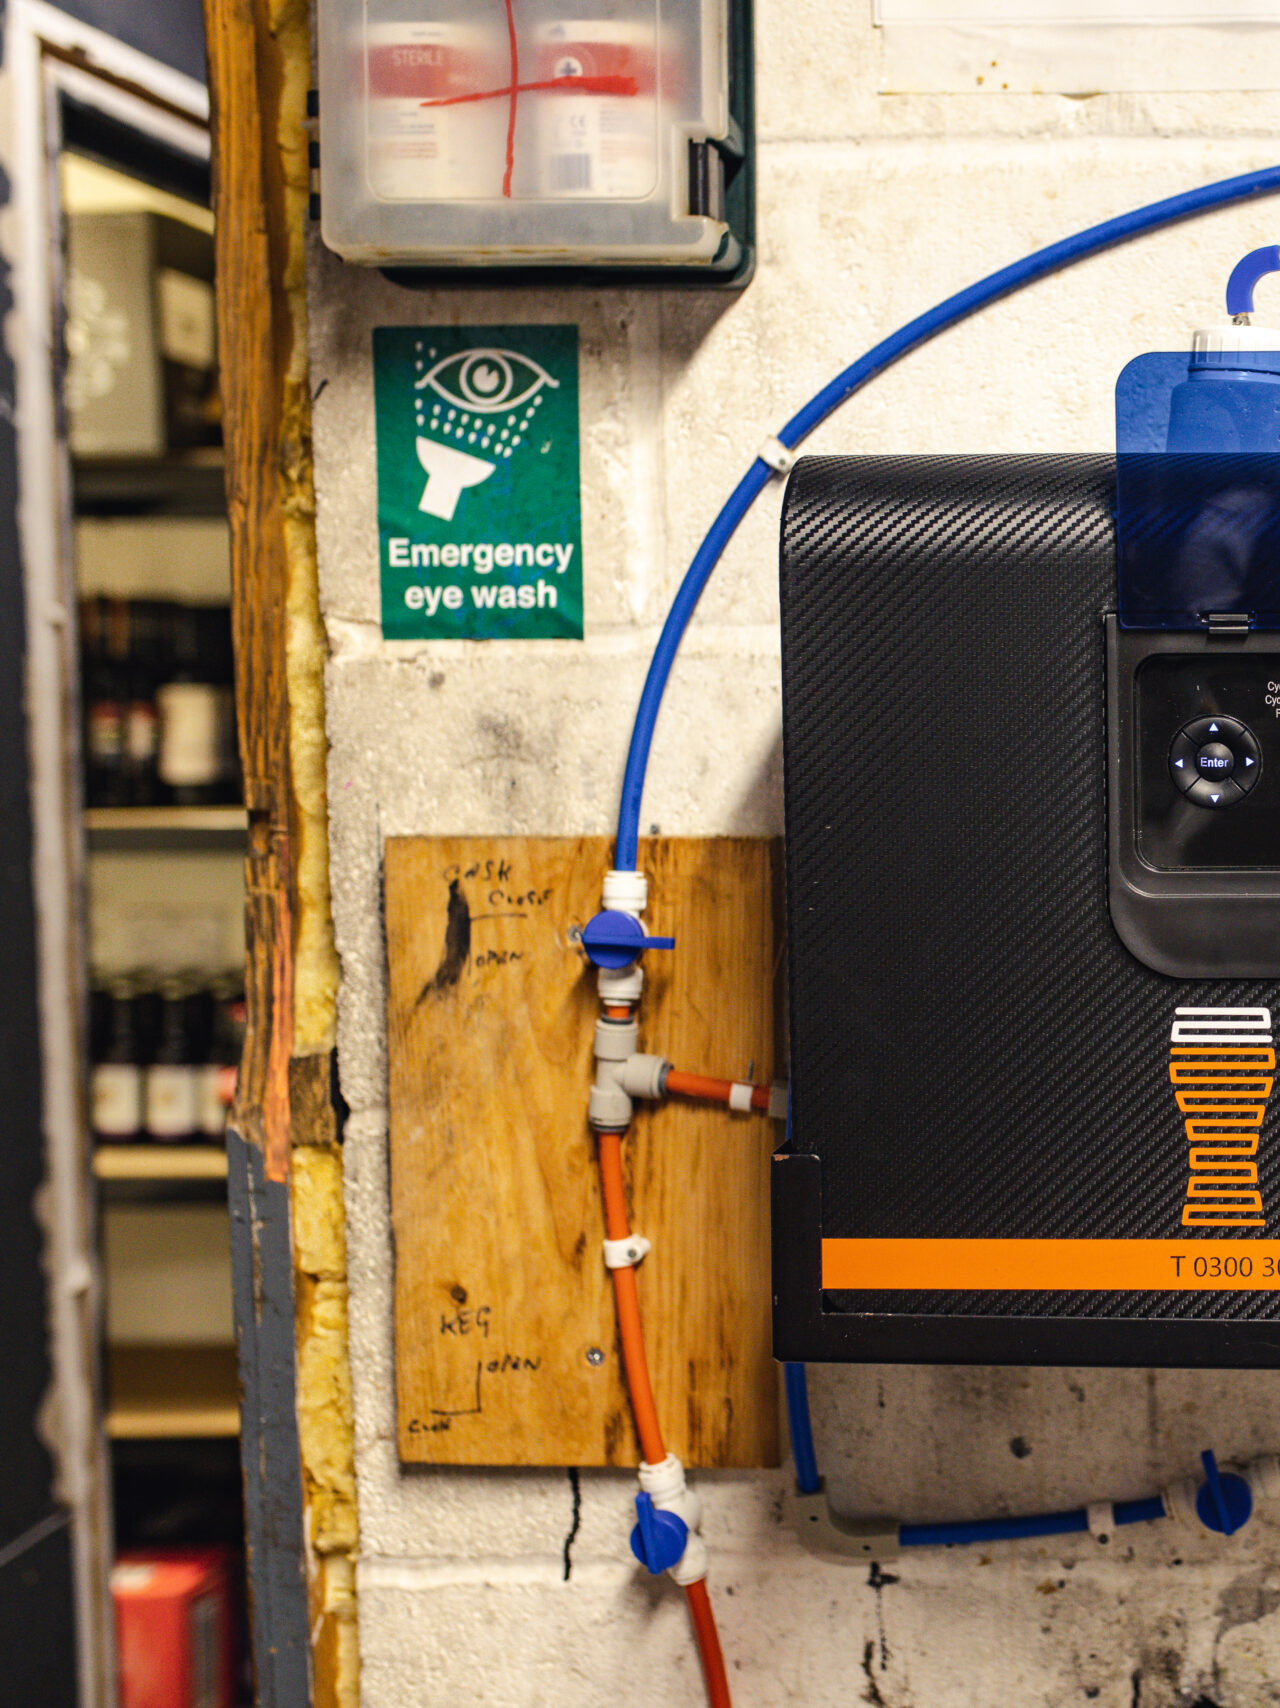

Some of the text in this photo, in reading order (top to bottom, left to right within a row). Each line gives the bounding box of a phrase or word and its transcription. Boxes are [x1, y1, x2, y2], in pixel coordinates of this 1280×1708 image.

[388, 537, 574, 574] Emergency
[404, 579, 558, 616] eye wash
[1200, 757, 1229, 767] Enter
[1170, 1256, 1187, 1277] T
[1193, 1256, 1253, 1278] 0300
